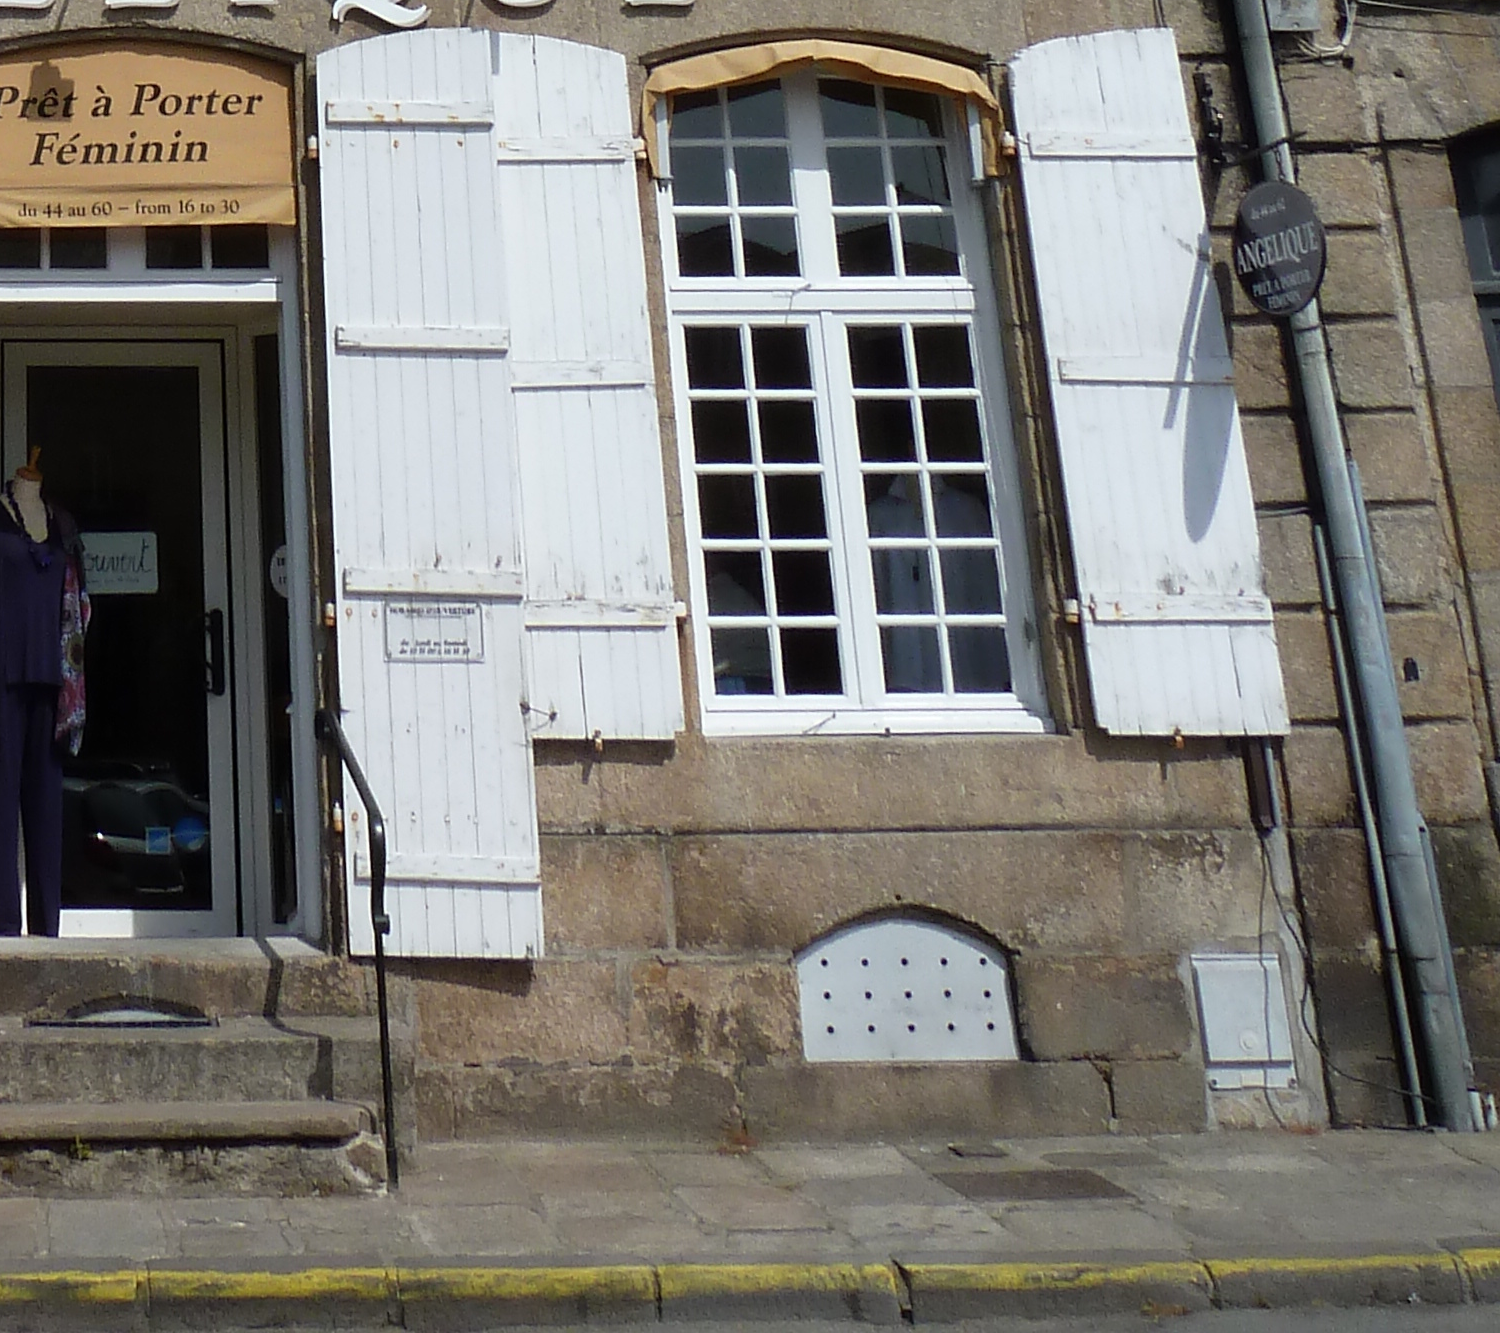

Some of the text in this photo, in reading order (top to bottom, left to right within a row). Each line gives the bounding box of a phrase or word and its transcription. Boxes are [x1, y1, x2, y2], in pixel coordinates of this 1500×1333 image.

[91, 85, 113, 117] à
[130, 82, 263, 117] Porter
[29, 130, 209, 166] Féminin
[18, 202, 37, 217] du
[42, 203, 62, 219] 44
[67, 205, 86, 218] au
[91, 201, 113, 217] 60
[135, 199, 171, 215] from
[179, 199, 195, 214] 16
[200, 201, 215, 215] to
[220, 199, 240, 214] 30
[1237, 221, 1319, 275] ANGELIQUE
